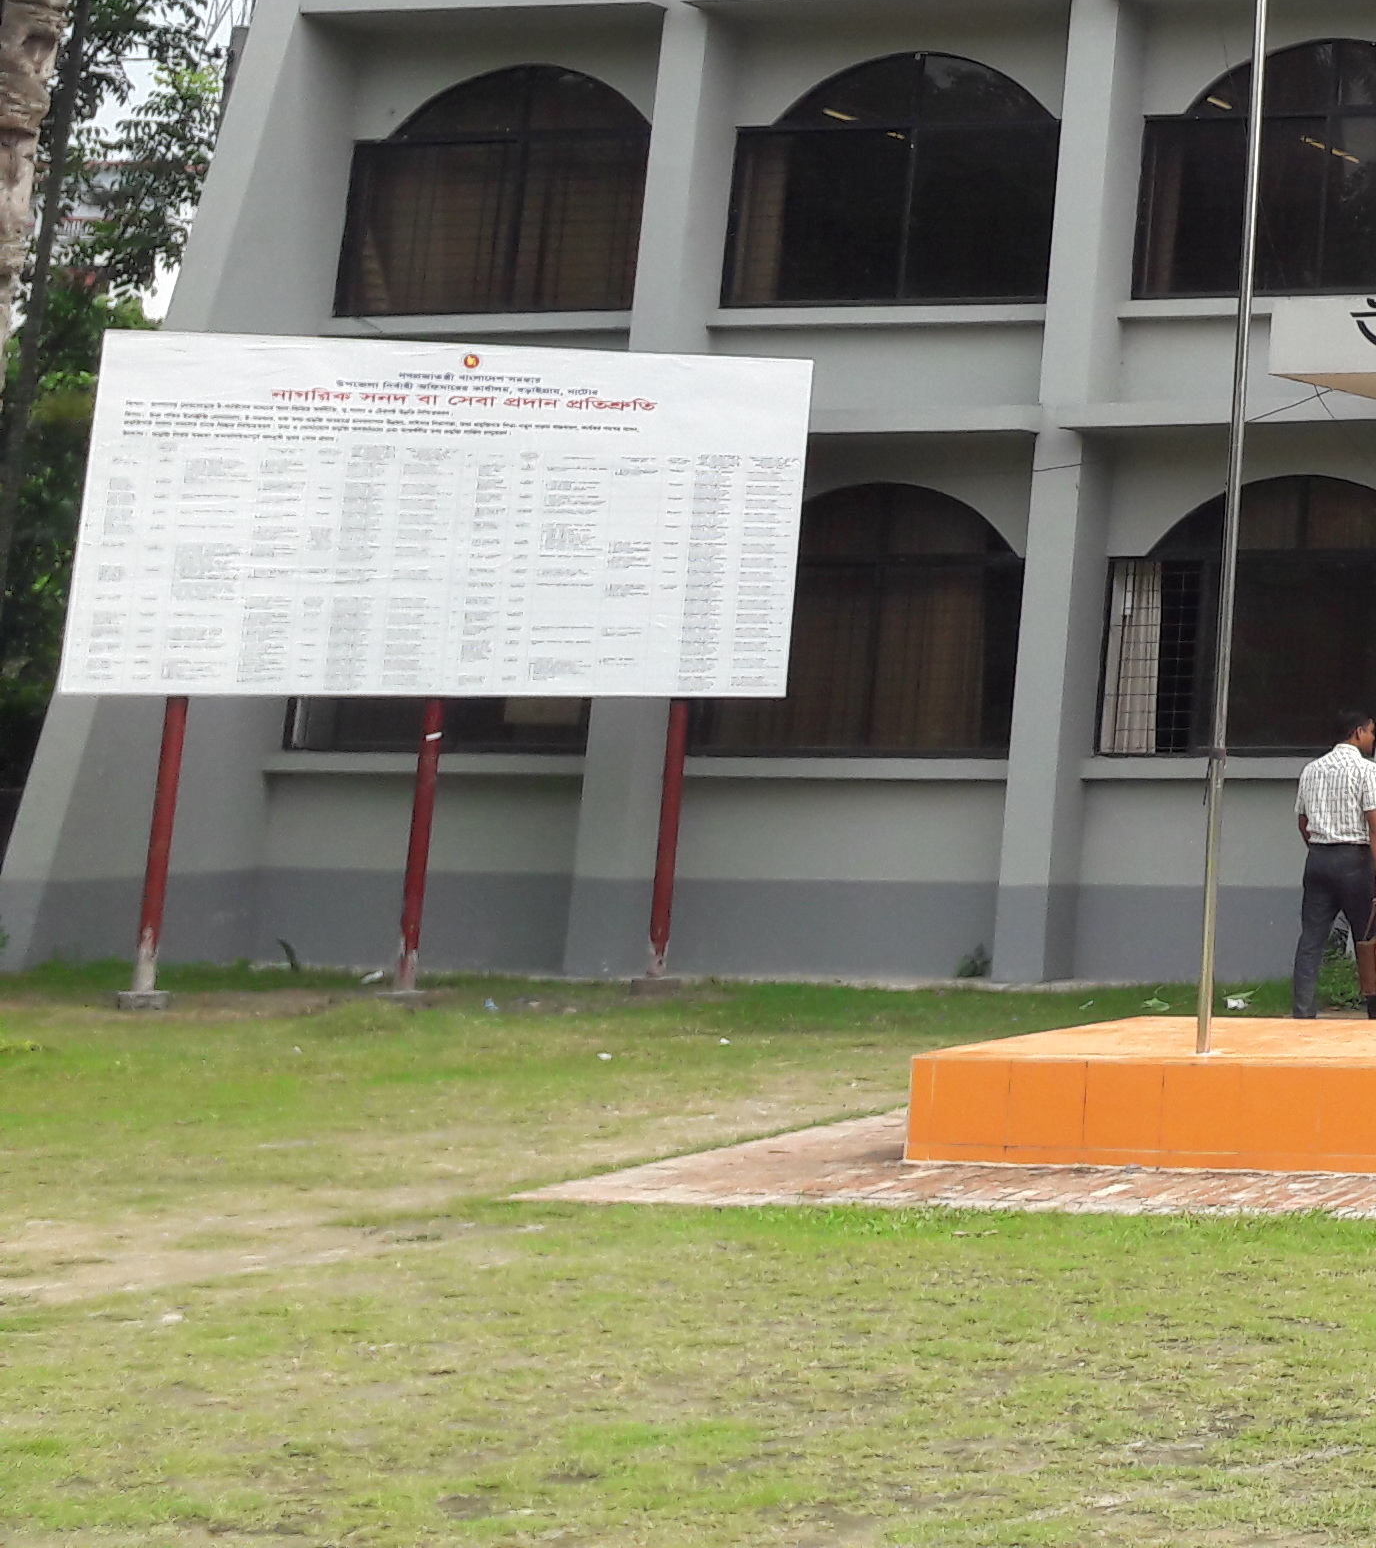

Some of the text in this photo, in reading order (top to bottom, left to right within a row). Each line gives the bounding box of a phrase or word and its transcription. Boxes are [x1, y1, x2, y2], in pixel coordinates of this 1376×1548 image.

[271, 387, 353, 402] নাগরিক
[359, 392, 410, 405] সনদ
[415, 394, 441, 406] বা
[448, 395, 497, 408] সেবা
[503, 395, 560, 410] প্রদান
